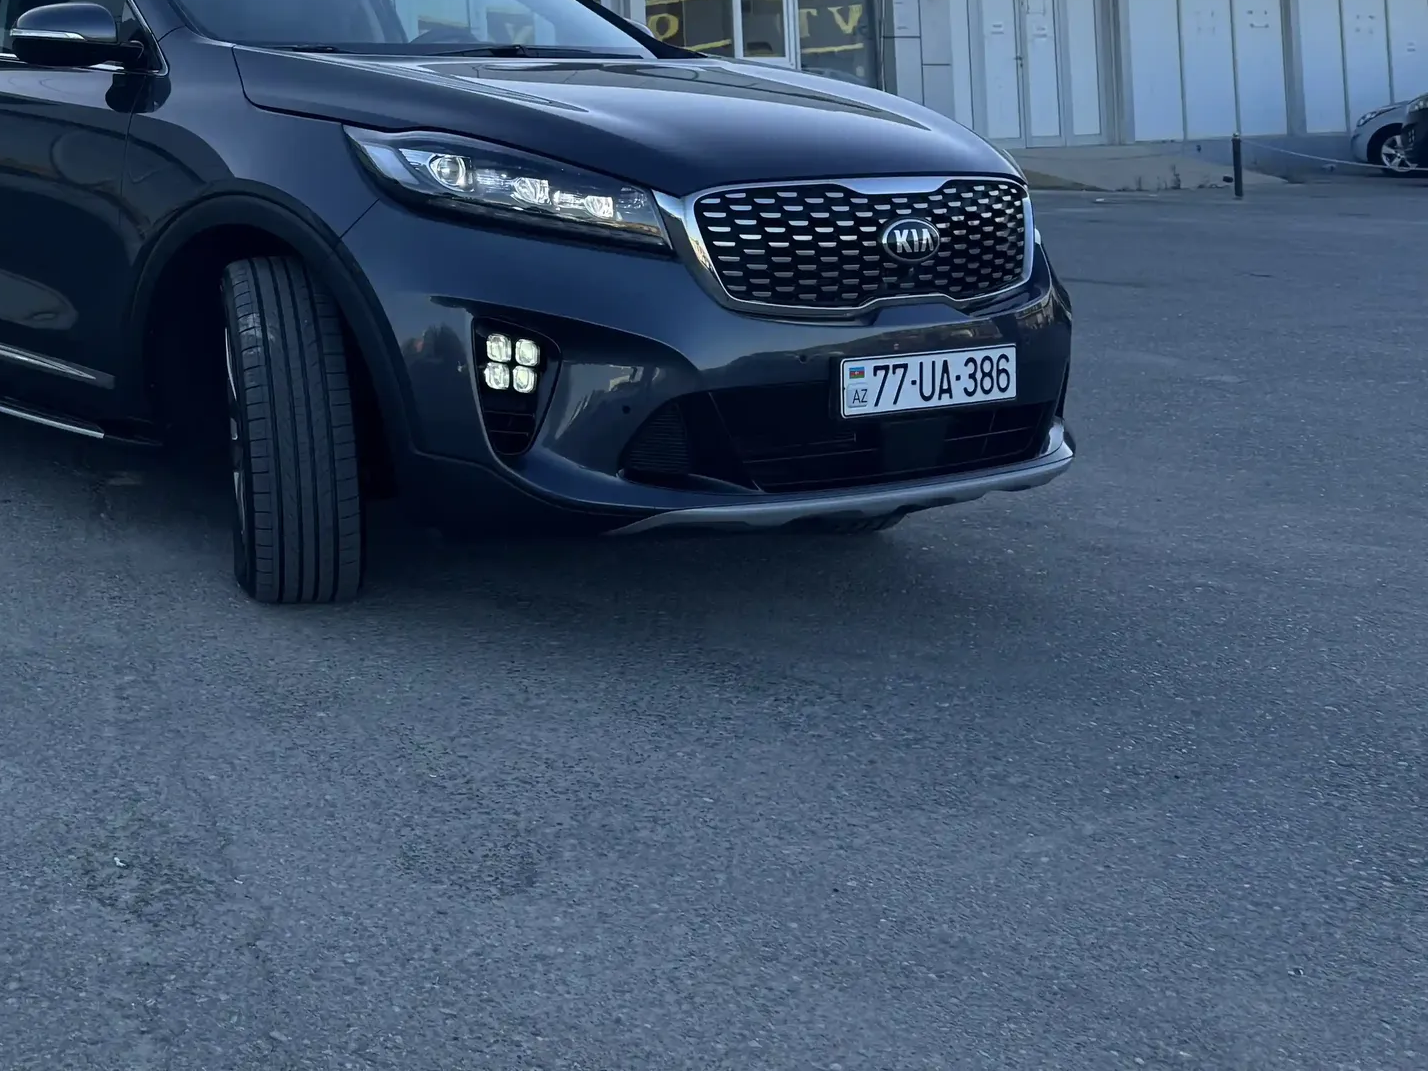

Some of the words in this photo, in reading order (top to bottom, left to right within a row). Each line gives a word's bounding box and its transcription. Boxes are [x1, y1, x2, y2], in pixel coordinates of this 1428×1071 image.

[893, 228, 934, 254] KIA
[873, 353, 1010, 407] 77-UA-386
[852, 388, 868, 404] AZ
